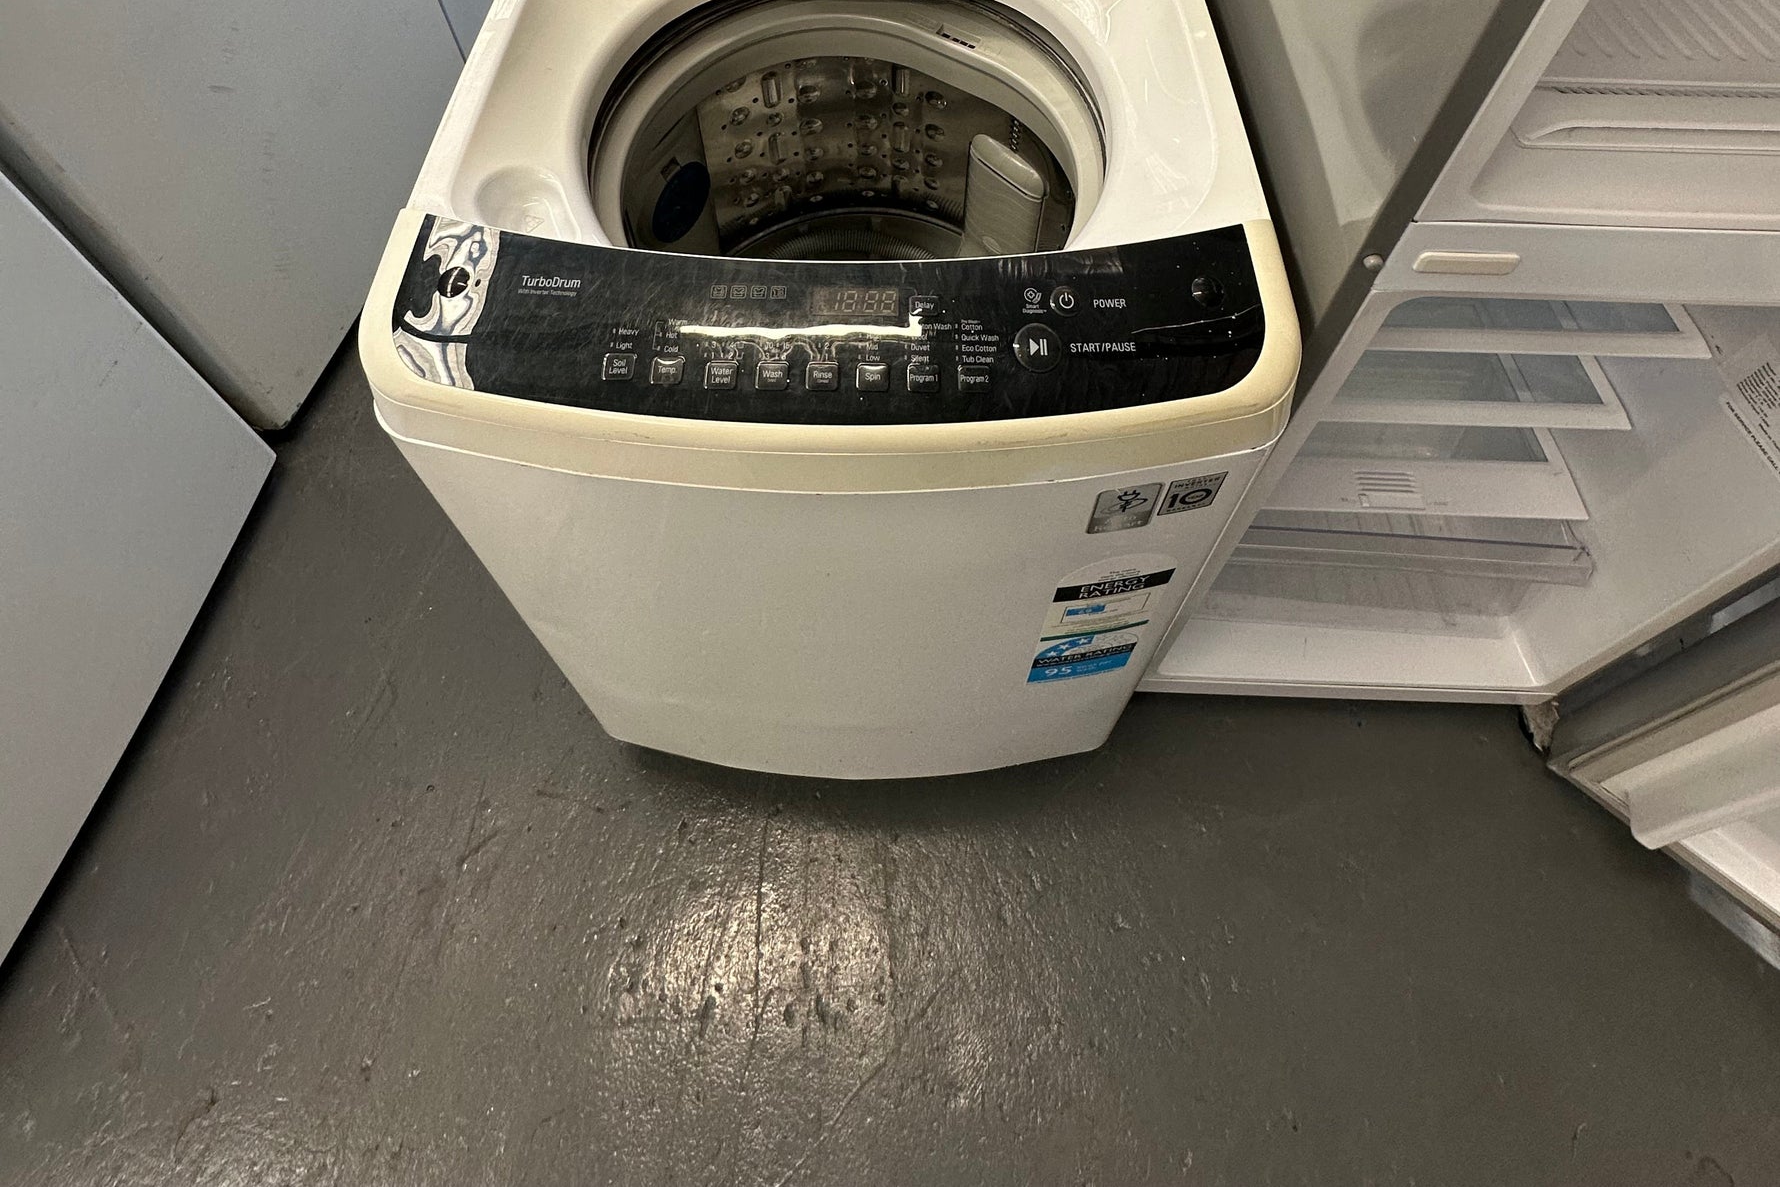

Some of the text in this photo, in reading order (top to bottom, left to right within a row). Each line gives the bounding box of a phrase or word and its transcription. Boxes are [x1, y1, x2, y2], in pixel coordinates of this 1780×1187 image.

[522, 275, 581, 289] TurboDrum
[914, 301, 935, 310] Delay
[1093, 298, 1127, 309] POWER
[933, 322, 952, 330] Wash
[961, 323, 983, 331] Cotton
[618, 327, 640, 336] Heavy
[961, 333, 999, 342] Quick Wash
[615, 342, 633, 351] Light
[663, 345, 679, 353] Cold
[910, 342, 930, 351] Duvet
[961, 344, 974, 352] Eco
[1069, 342, 1137, 354] START/PAUSE
[910, 354, 930, 362] Silent
[962, 355, 994, 363] Tub Clean
[612, 359, 627, 367] Soil
[608, 366, 628, 374] Level
[657, 365, 678, 375] Temp.
[710, 367, 734, 375] Water
[762, 370, 783, 378] Wash
[813, 370, 833, 379] Rinse
[711, 375, 731, 384] Level
[864, 372, 881, 381] Spin
[909, 374, 934, 383] Program
[960, 374, 985, 383] Program
[1080, 576, 1150, 593] ENERGY
[1079, 583, 1145, 599] RATING
[1038, 654, 1083, 664] WATER
[1044, 666, 1073, 677] 95
